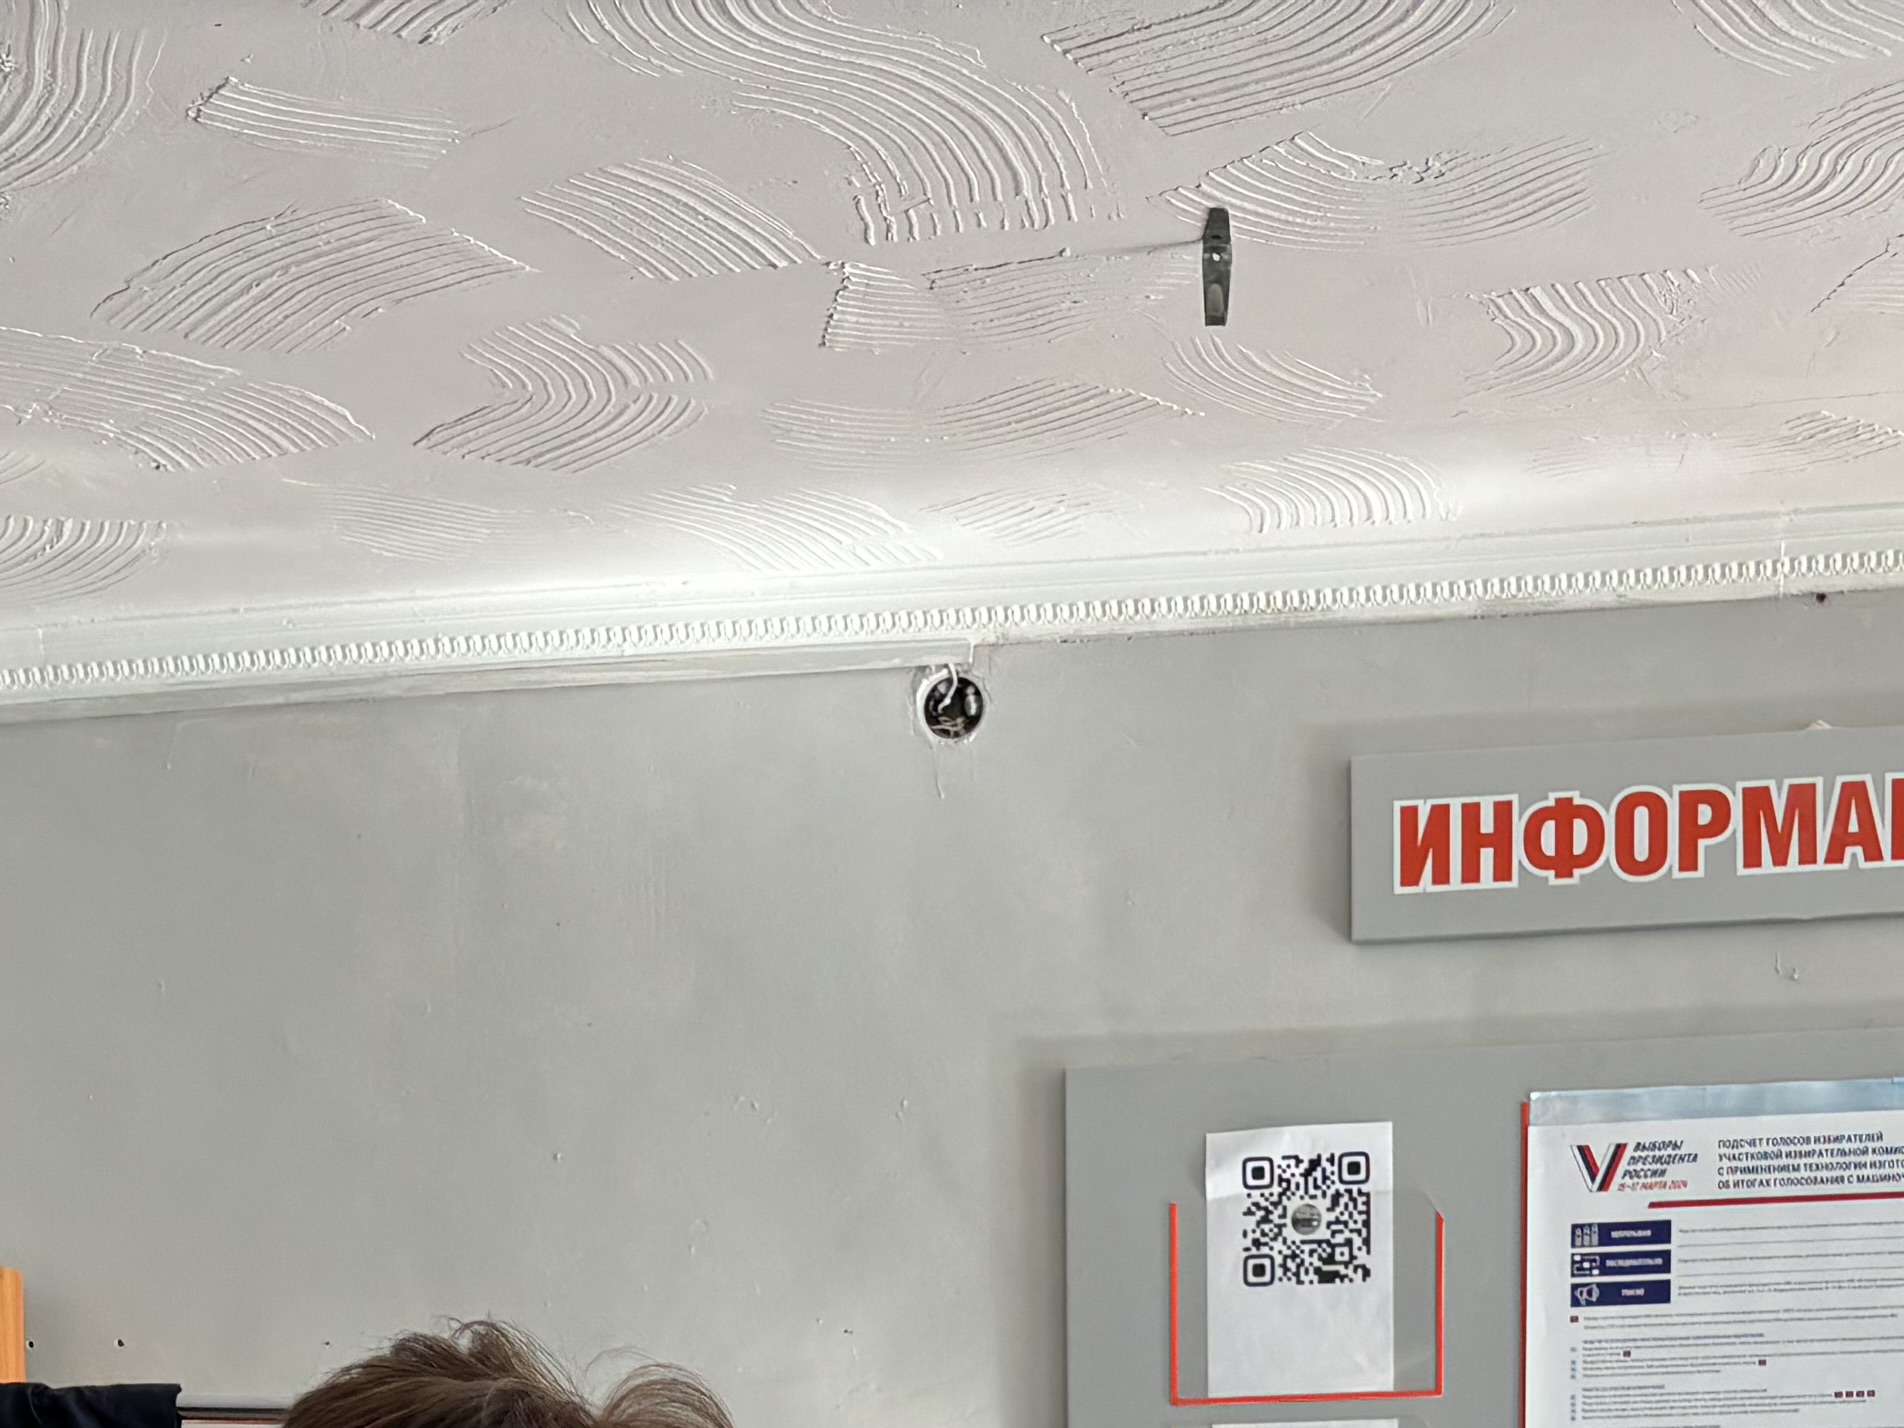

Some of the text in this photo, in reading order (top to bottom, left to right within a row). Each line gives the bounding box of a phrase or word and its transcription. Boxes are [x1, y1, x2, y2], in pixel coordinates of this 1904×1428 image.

[1766, 1136, 1811, 1147] ГОЛОСОВ
[1814, 1131, 1883, 1145] ИЗБИРАТЕЛЕЙ
[1621, 1168, 1667, 1180] РОССИИ
